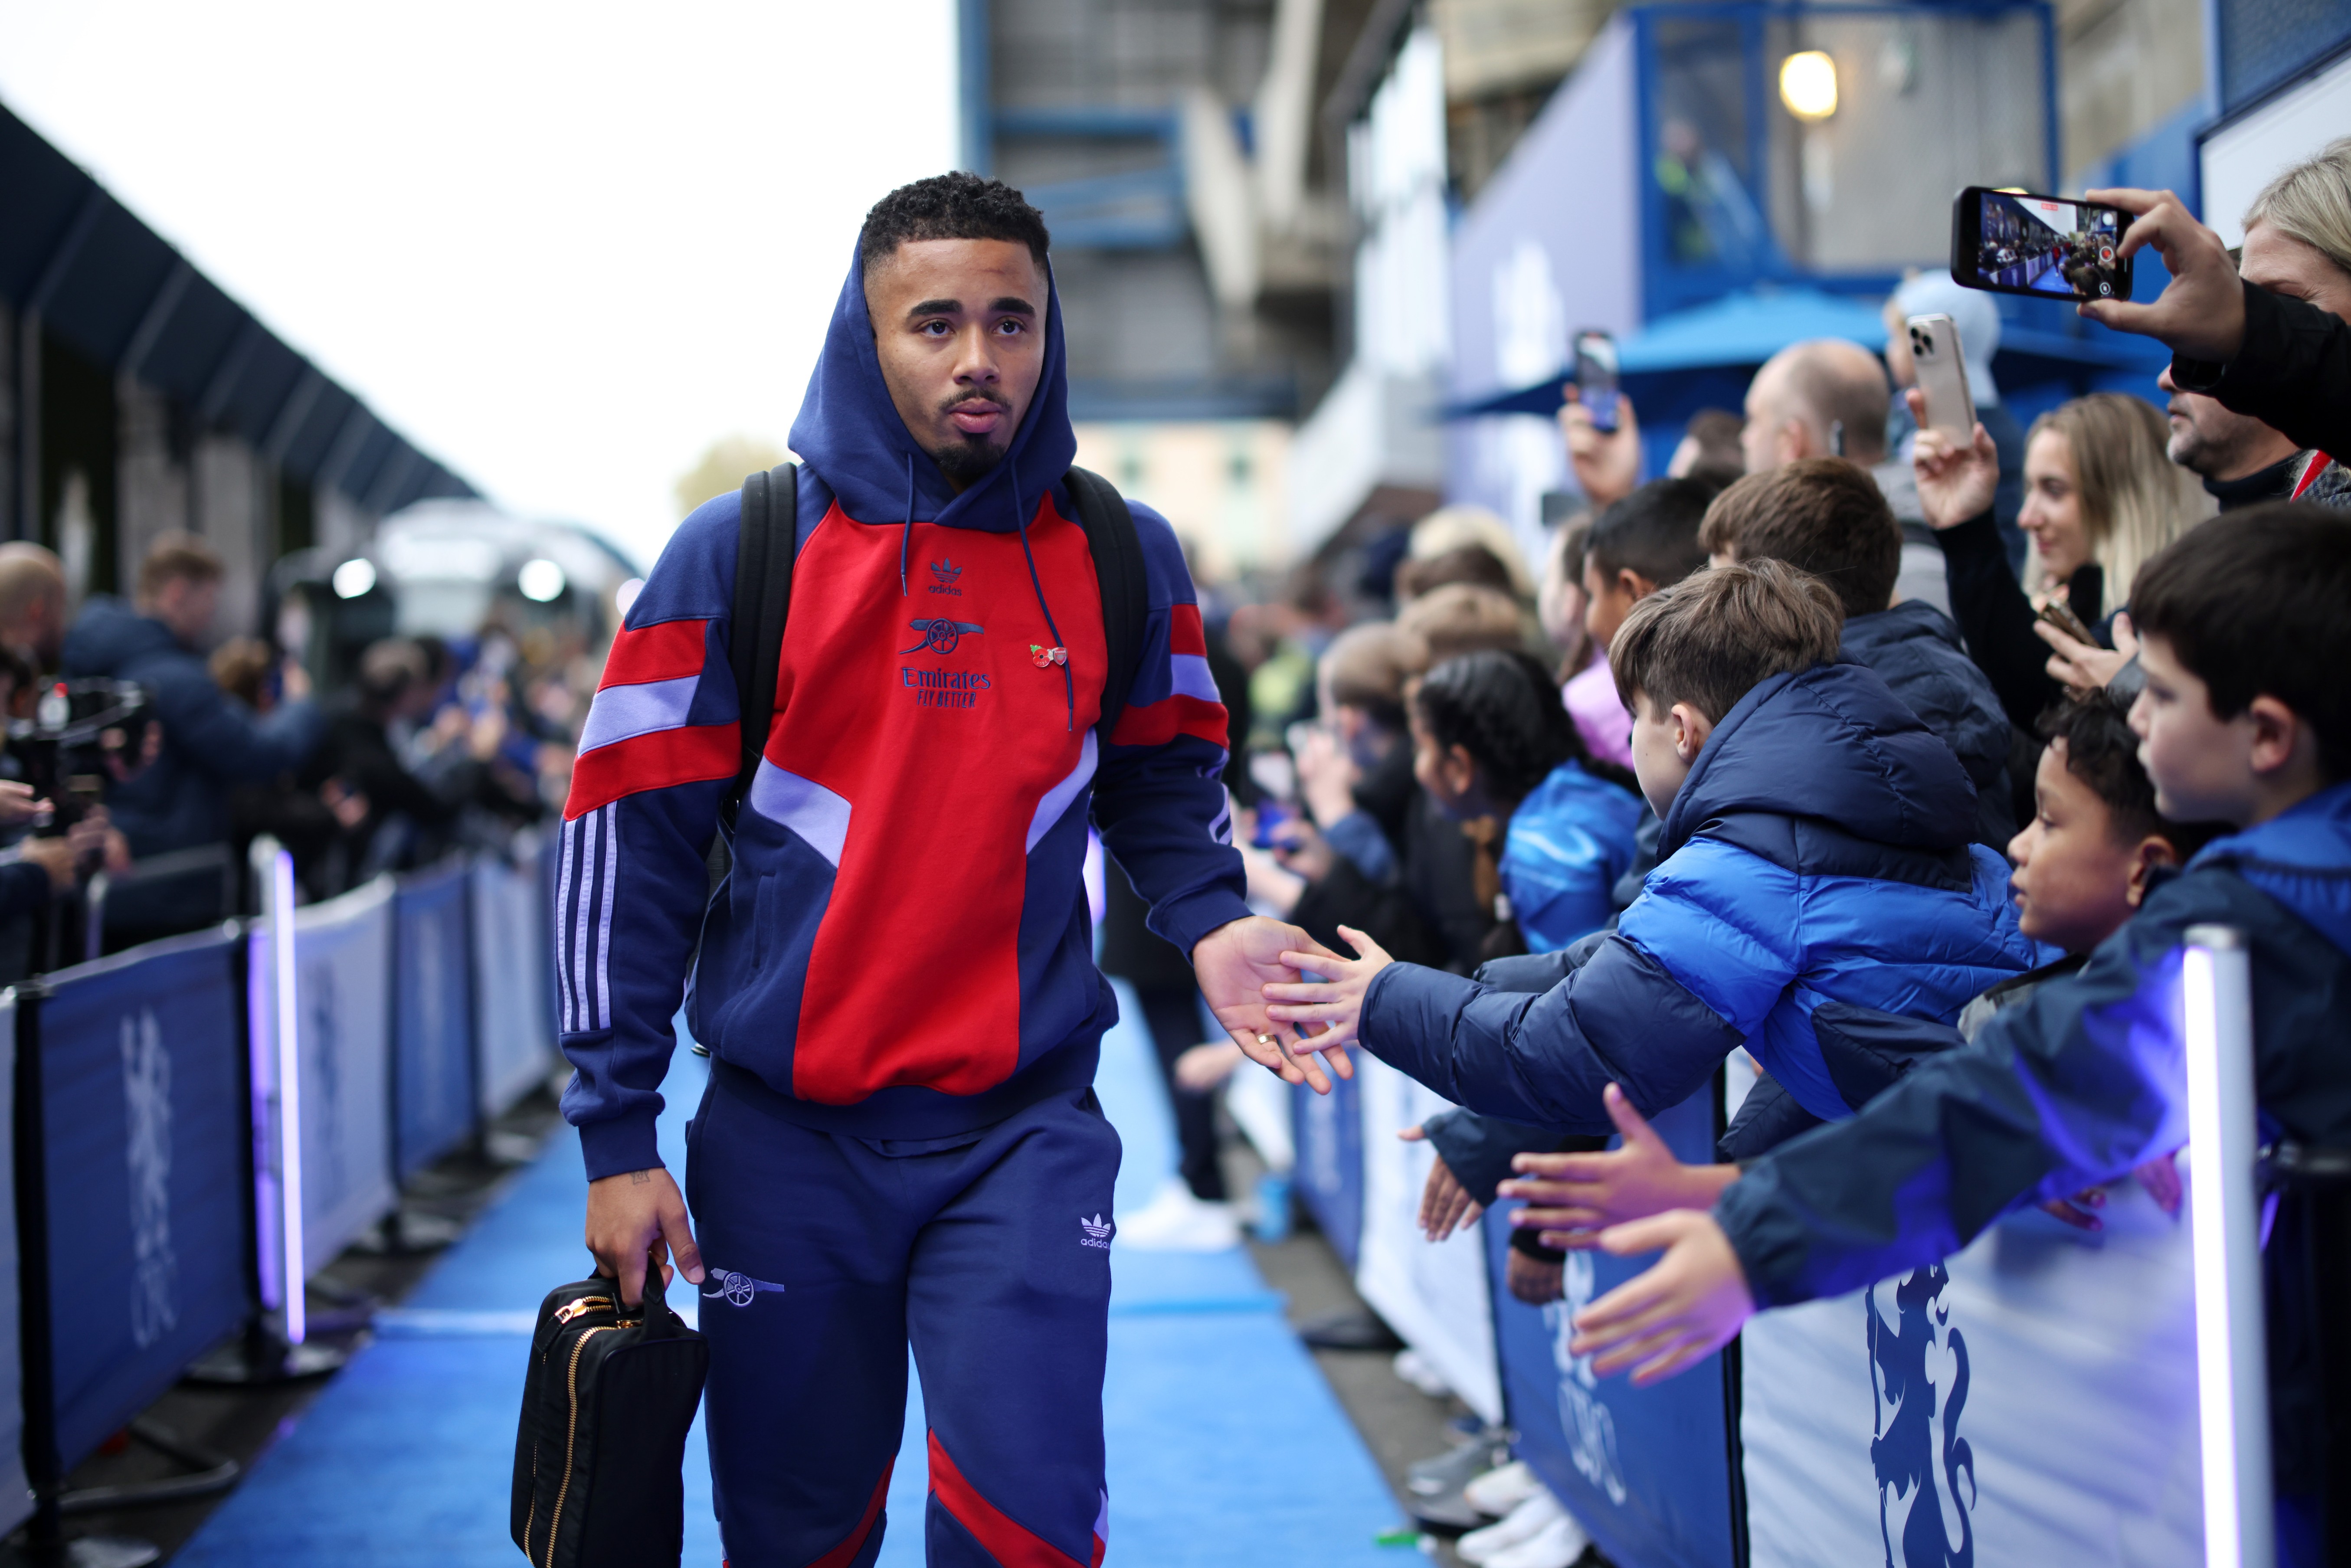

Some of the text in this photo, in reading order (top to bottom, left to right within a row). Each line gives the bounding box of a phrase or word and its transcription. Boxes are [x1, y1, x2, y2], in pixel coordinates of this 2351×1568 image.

[929, 584, 962, 596] adidas
[902, 667, 991, 689] Emirates
[917, 689, 976, 708] FLY BETTER
